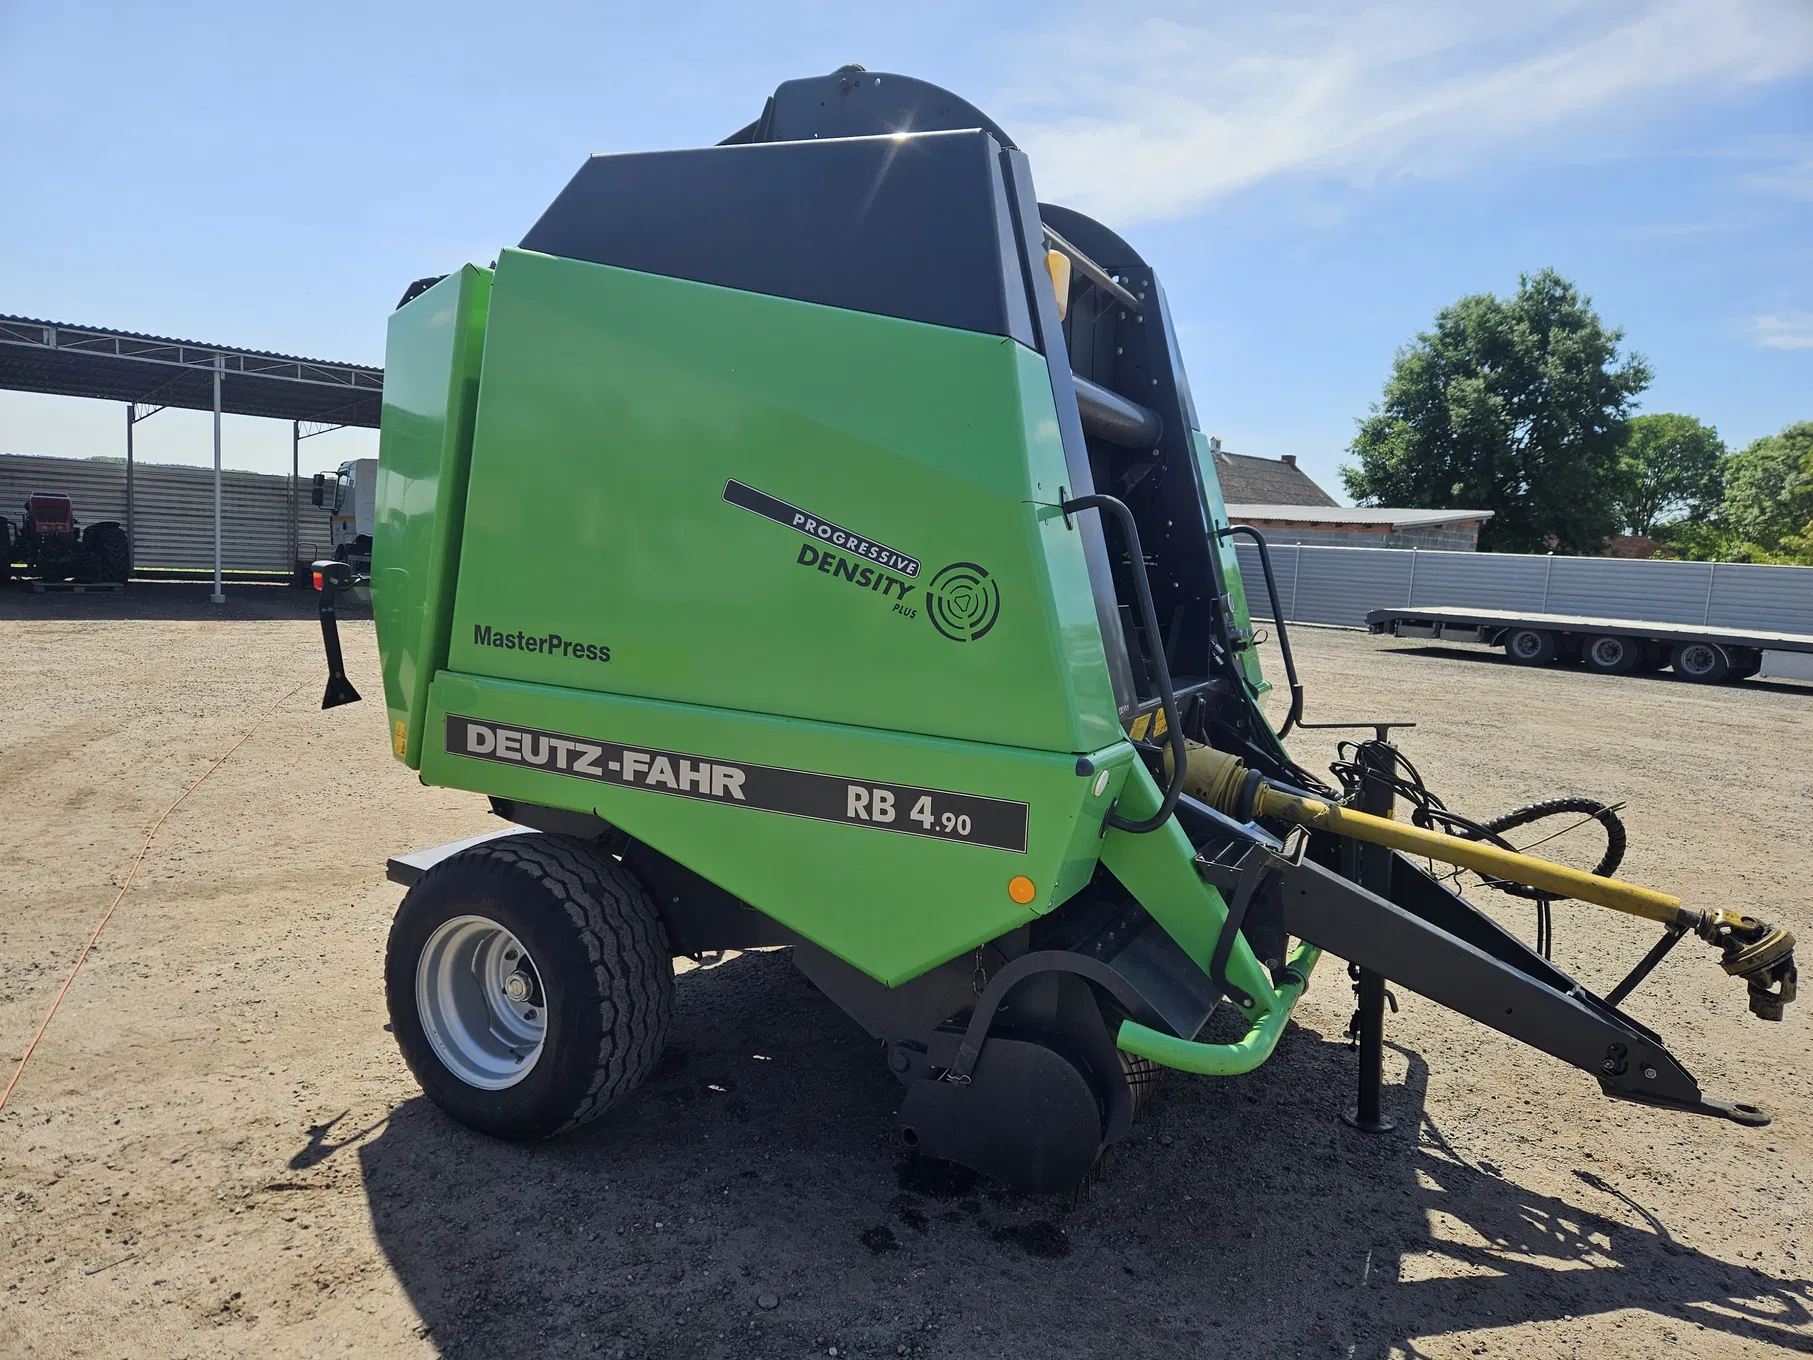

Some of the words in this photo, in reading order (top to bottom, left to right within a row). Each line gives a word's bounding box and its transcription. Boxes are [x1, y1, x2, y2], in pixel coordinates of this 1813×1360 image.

[792, 513, 917, 575] PROGRESSIVE
[796, 543, 915, 601] DENSITY
[892, 603, 917, 619] PLUS
[474, 624, 611, 662] MasterPress
[466, 723, 746, 800] DEUTZ-FAHR
[847, 785, 896, 823] RB
[910, 795, 971, 836] 4.90
